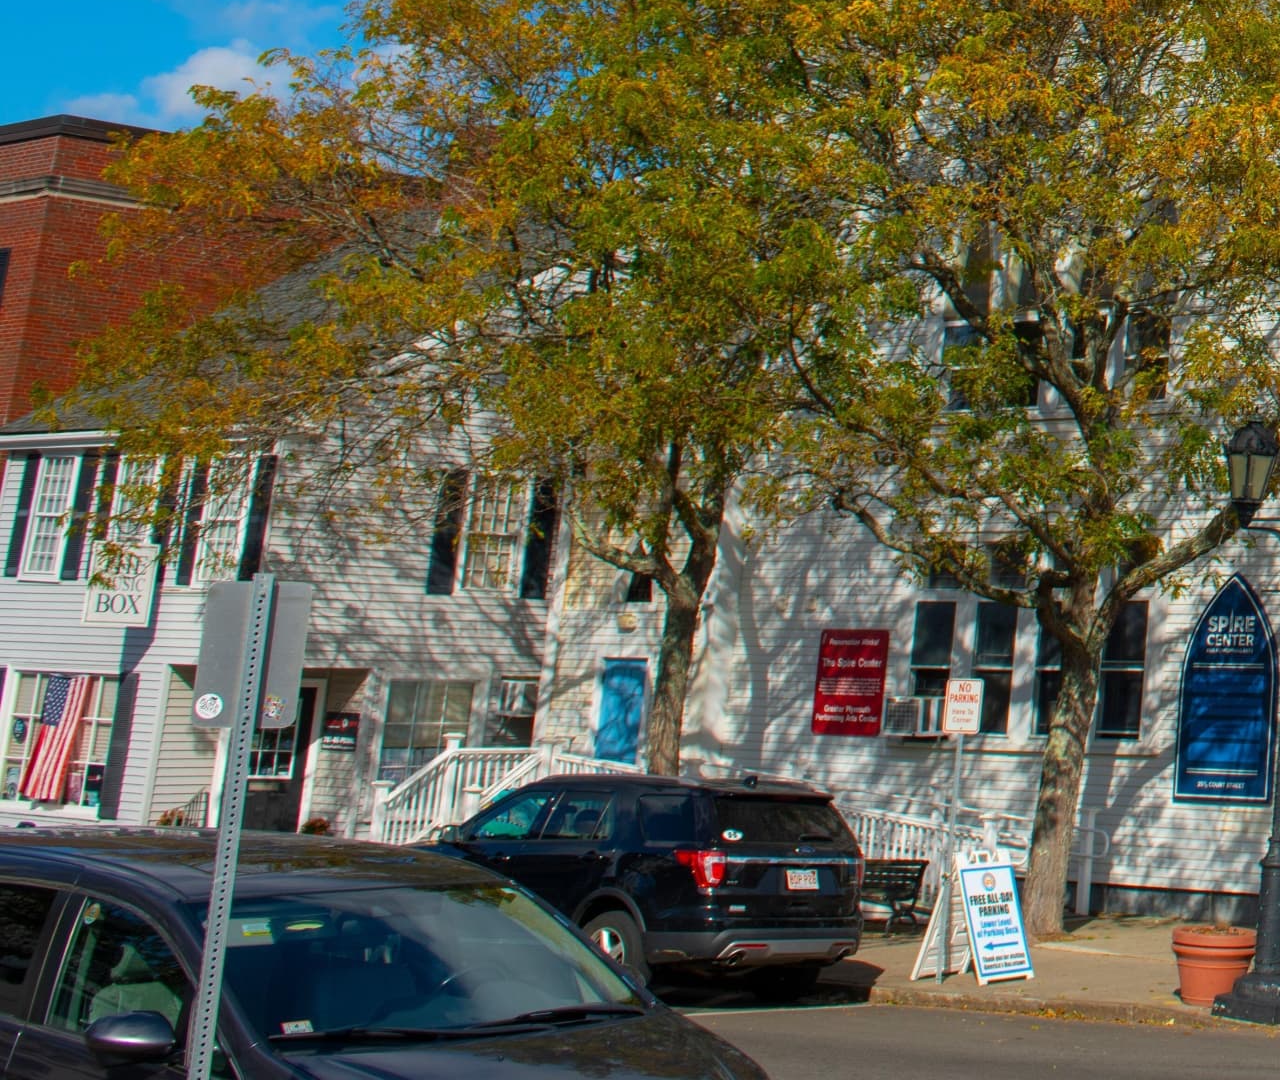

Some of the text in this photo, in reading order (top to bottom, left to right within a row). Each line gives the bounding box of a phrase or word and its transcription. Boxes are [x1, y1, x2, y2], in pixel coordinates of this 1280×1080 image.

[95, 593, 142, 614] BOX
[1208, 608, 1256, 633] SPIRE
[1206, 634, 1255, 646] CENTER
[823, 657, 882, 669] The Spire Center
[958, 683, 972, 693] NO
[949, 692, 979, 704] PARKING
[970, 892, 1014, 906] FREE ALL-DAY
[979, 904, 1009, 917] PARKING
